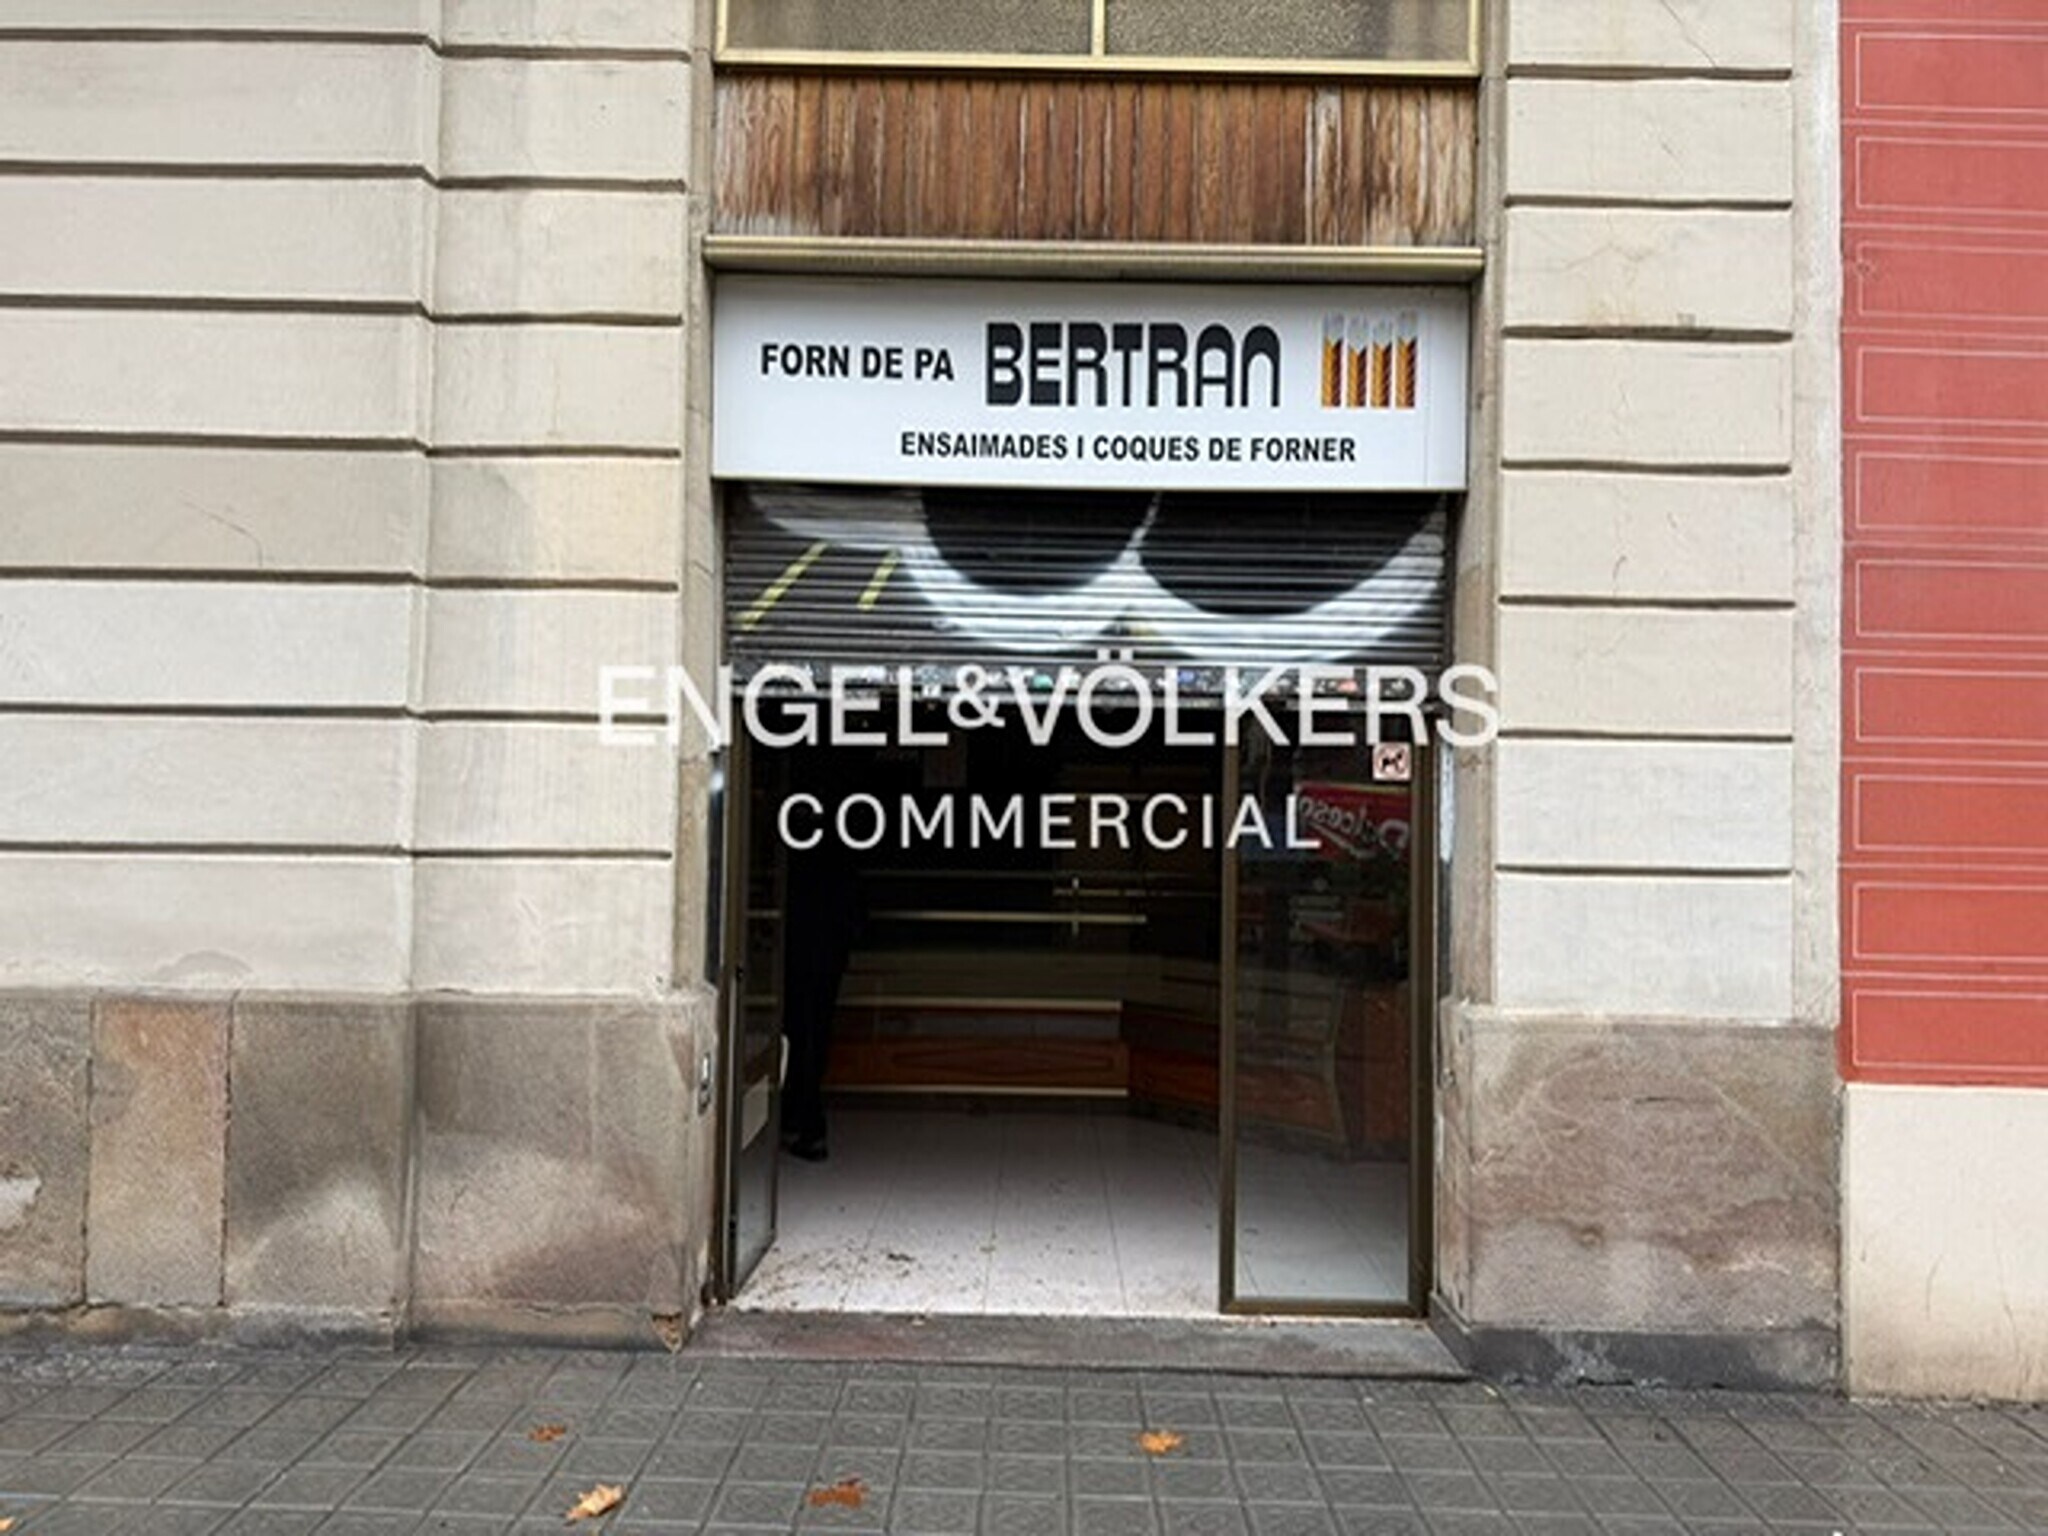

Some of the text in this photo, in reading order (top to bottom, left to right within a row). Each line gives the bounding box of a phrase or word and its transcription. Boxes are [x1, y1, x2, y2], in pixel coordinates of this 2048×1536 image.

[761, 343, 955, 381] FORN DE PA
[985, 322, 1281, 408] BERTRAN
[901, 431, 1356, 462] ENSAIMADES I COQUES DE FORNER
